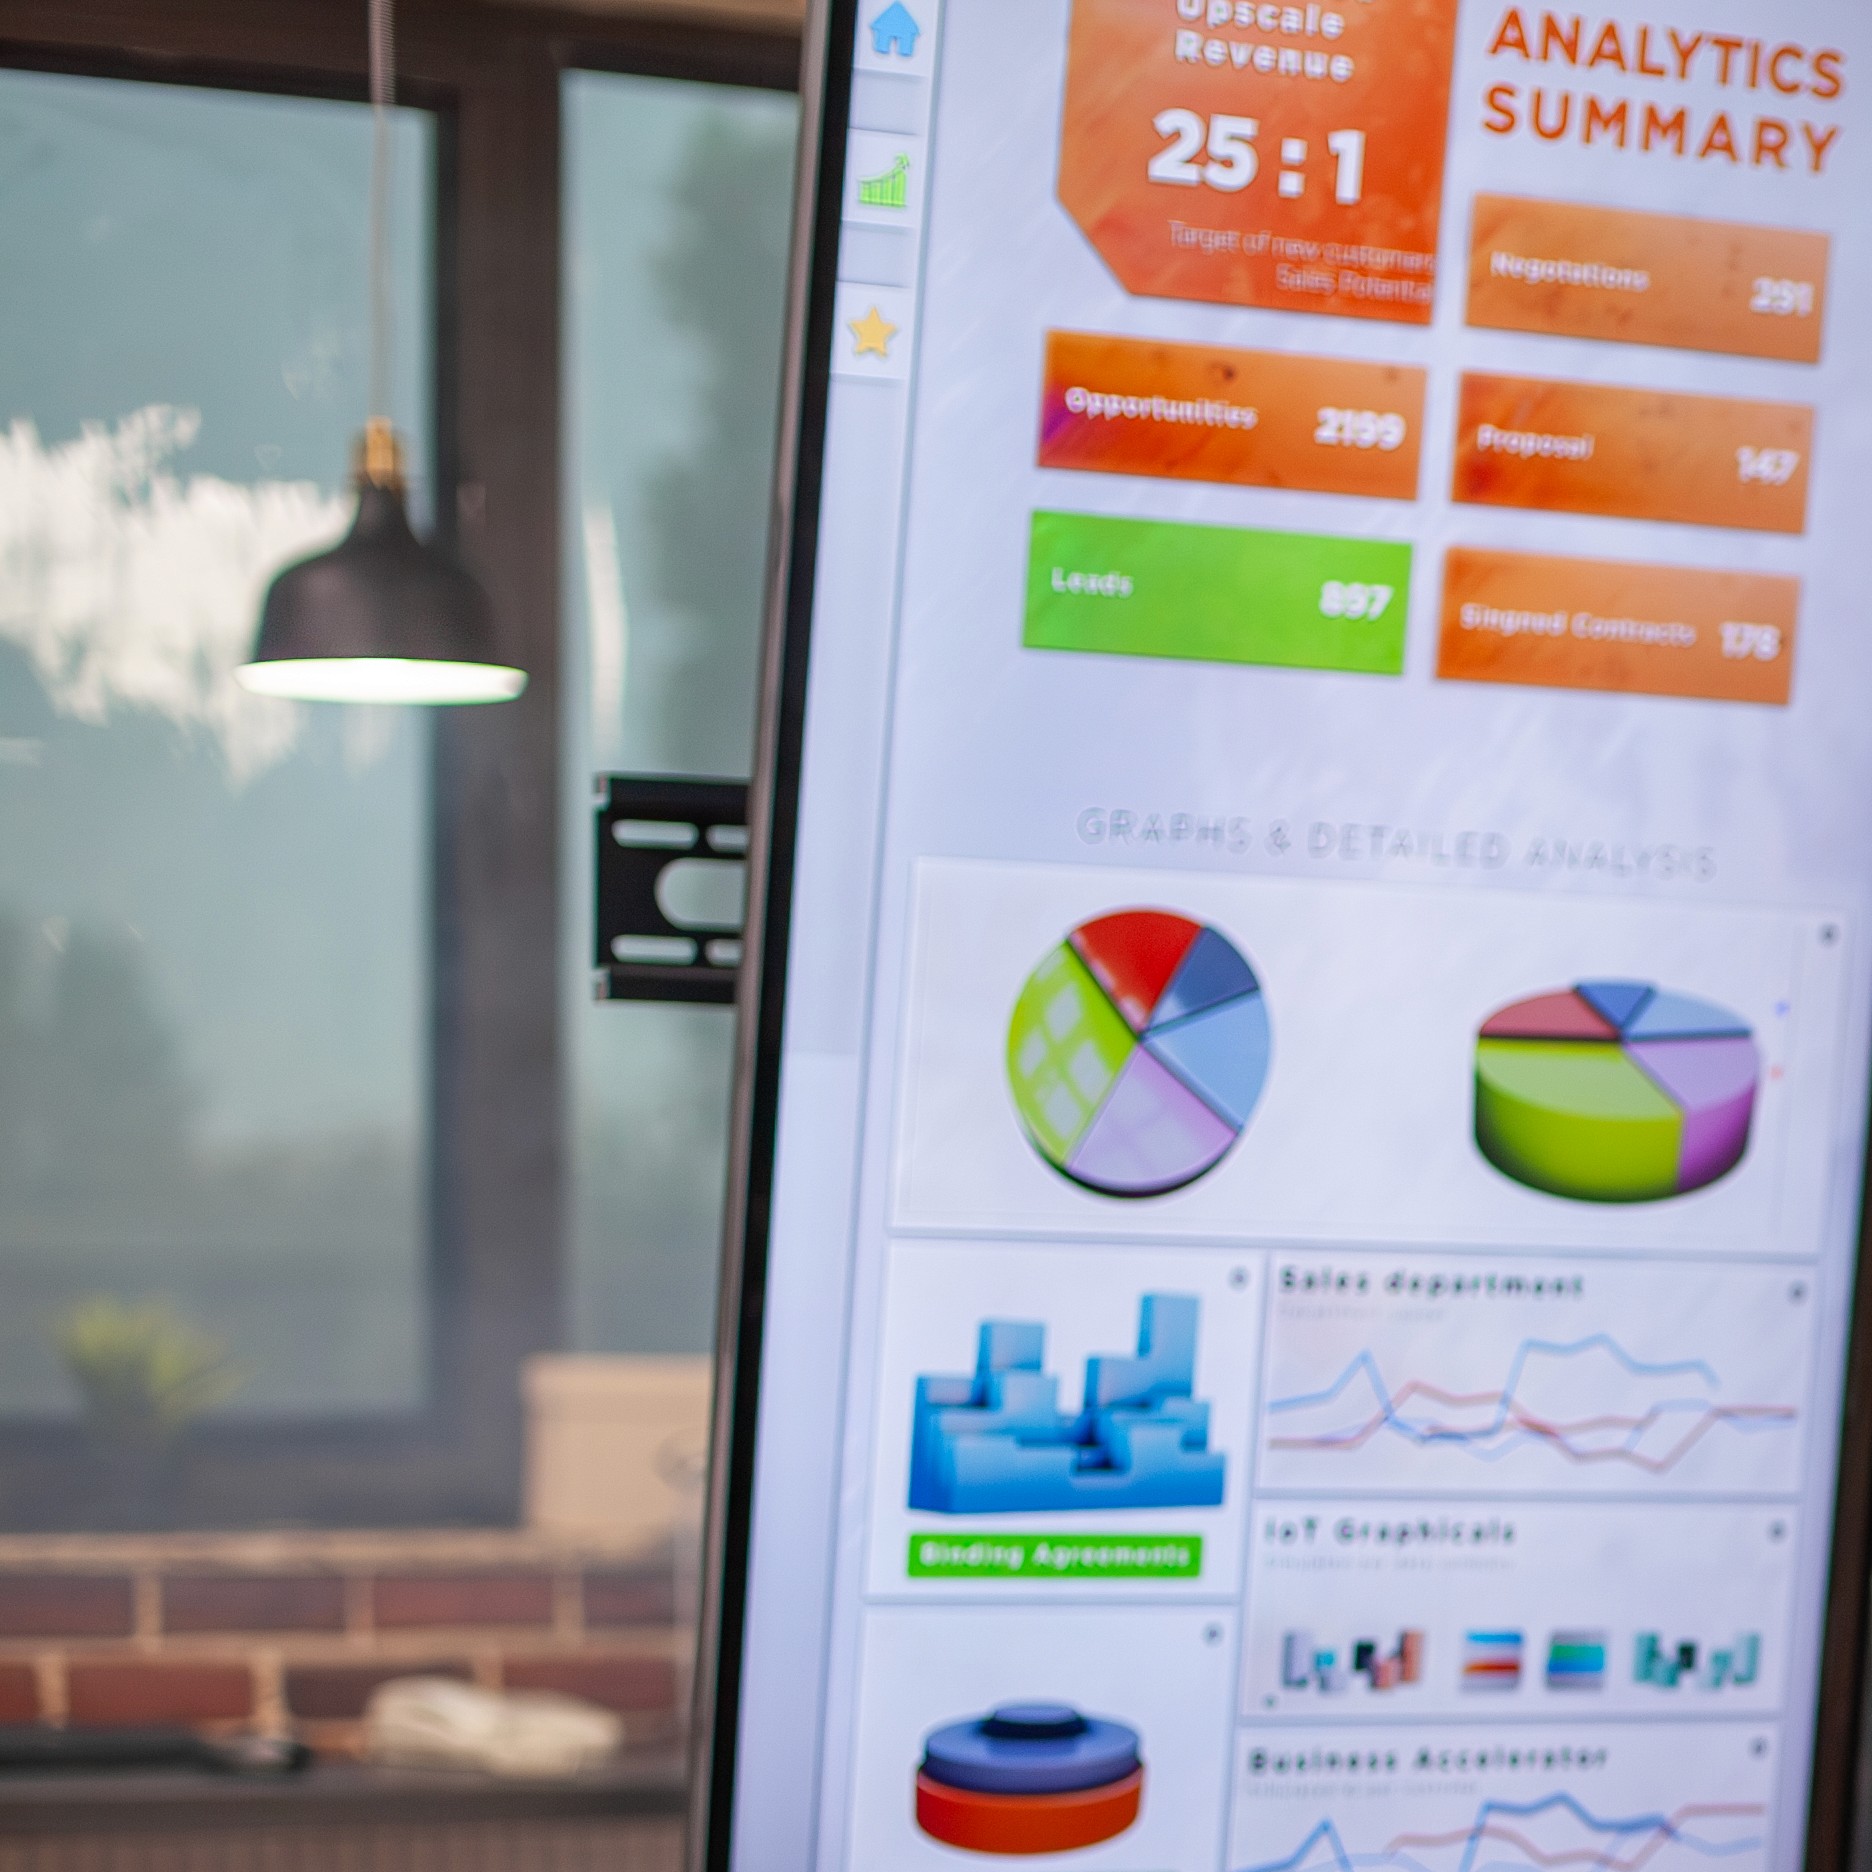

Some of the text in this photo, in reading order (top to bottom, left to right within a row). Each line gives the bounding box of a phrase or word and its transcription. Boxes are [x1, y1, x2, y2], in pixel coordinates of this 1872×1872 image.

[1177, 0, 1345, 40] Upscale
[1175, 29, 1355, 84] Revenue
[1489, 8, 1842, 99] ANALYTICS
[1483, 84, 1838, 172] SUMMARY
[1147, 107, 1260, 193] 25
[1327, 128, 1367, 206] 1
[1064, 385, 1260, 431] Opportunities
[1313, 405, 1406, 452] 2199
[1477, 423, 1595, 461] Proposal
[1051, 566, 1134, 600] Leads
[1316, 579, 1393, 621] 897
[1076, 806, 1719, 883] GRAPHS & DETAILED ANALYSIS
[1280, 1264, 1584, 1302] Sales department
[920, 1540, 1191, 1571] Binding Agreements
[1249, 1744, 1607, 1776] Business Accelerator
